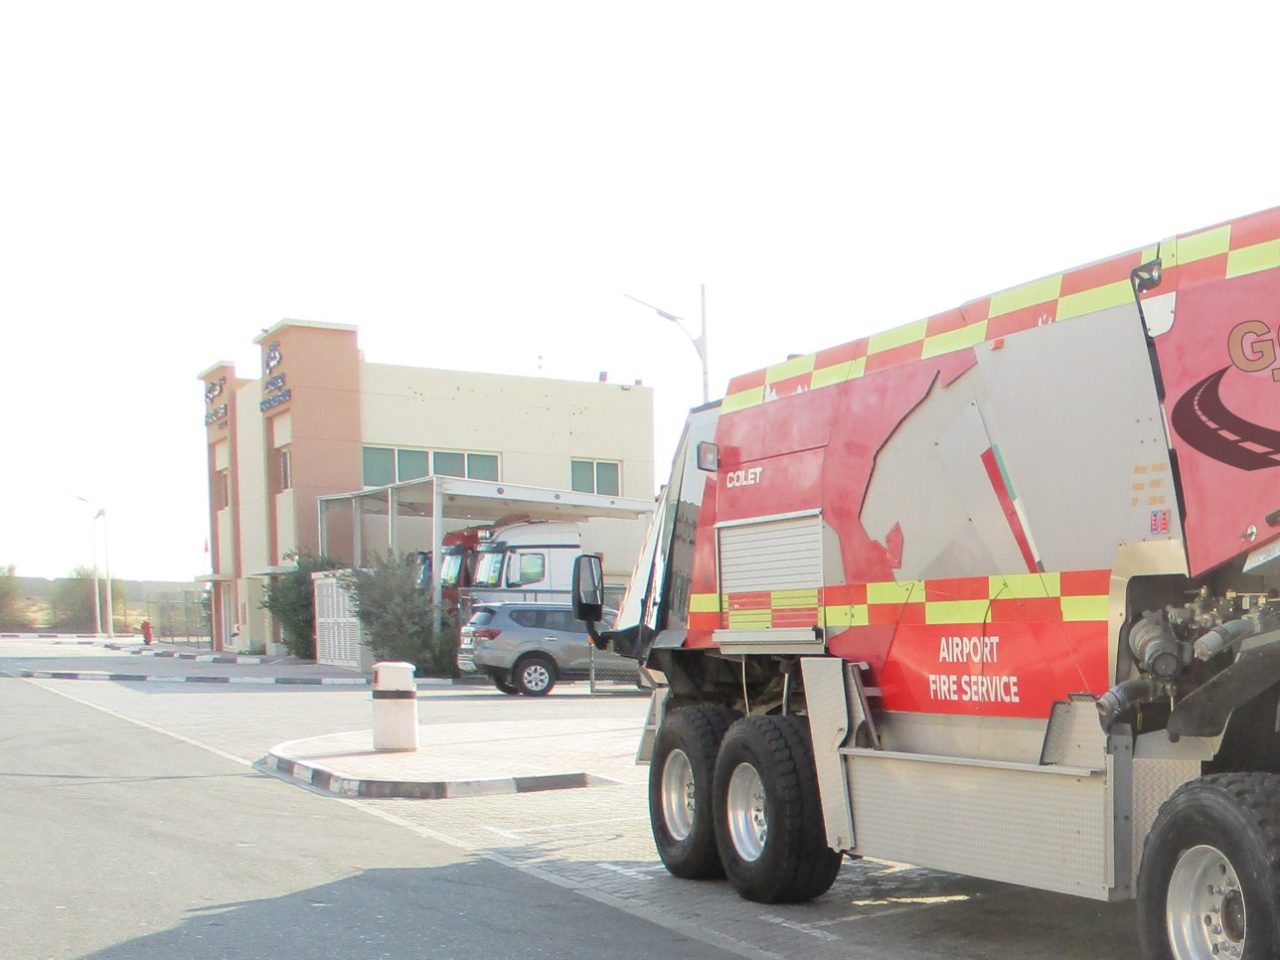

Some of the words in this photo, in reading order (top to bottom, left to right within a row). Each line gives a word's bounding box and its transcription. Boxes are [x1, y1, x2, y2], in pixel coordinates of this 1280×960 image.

[726, 466, 763, 489] COLET
[938, 635, 1000, 664] AIRPORT
[928, 674, 959, 701] FIRE
[961, 674, 1020, 704] SERVICE
